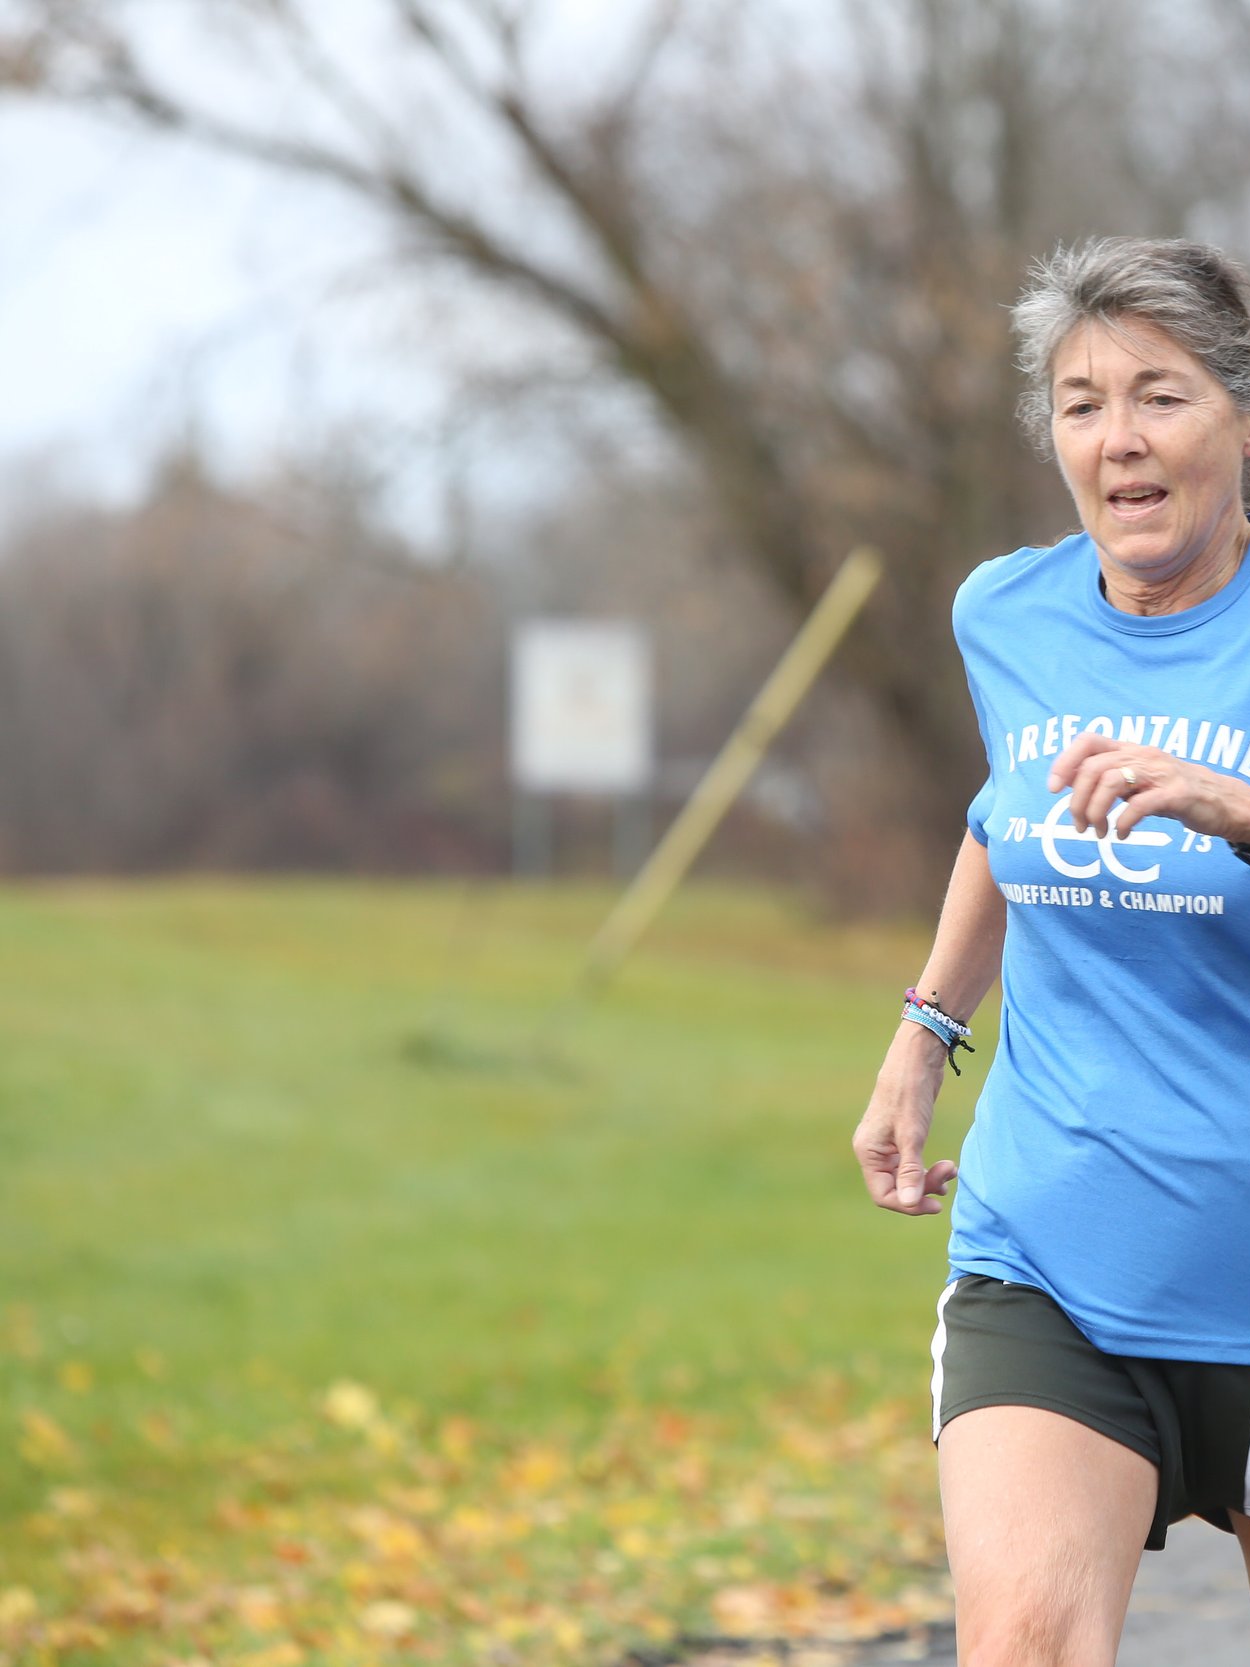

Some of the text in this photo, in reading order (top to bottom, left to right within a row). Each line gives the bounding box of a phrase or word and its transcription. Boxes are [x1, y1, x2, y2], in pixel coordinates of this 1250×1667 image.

[1002, 817, 1028, 843] 70
[1180, 826, 1213, 853] 73
[1099, 889, 1115, 908] &
[1119, 890, 1225, 915] CHAMPION
